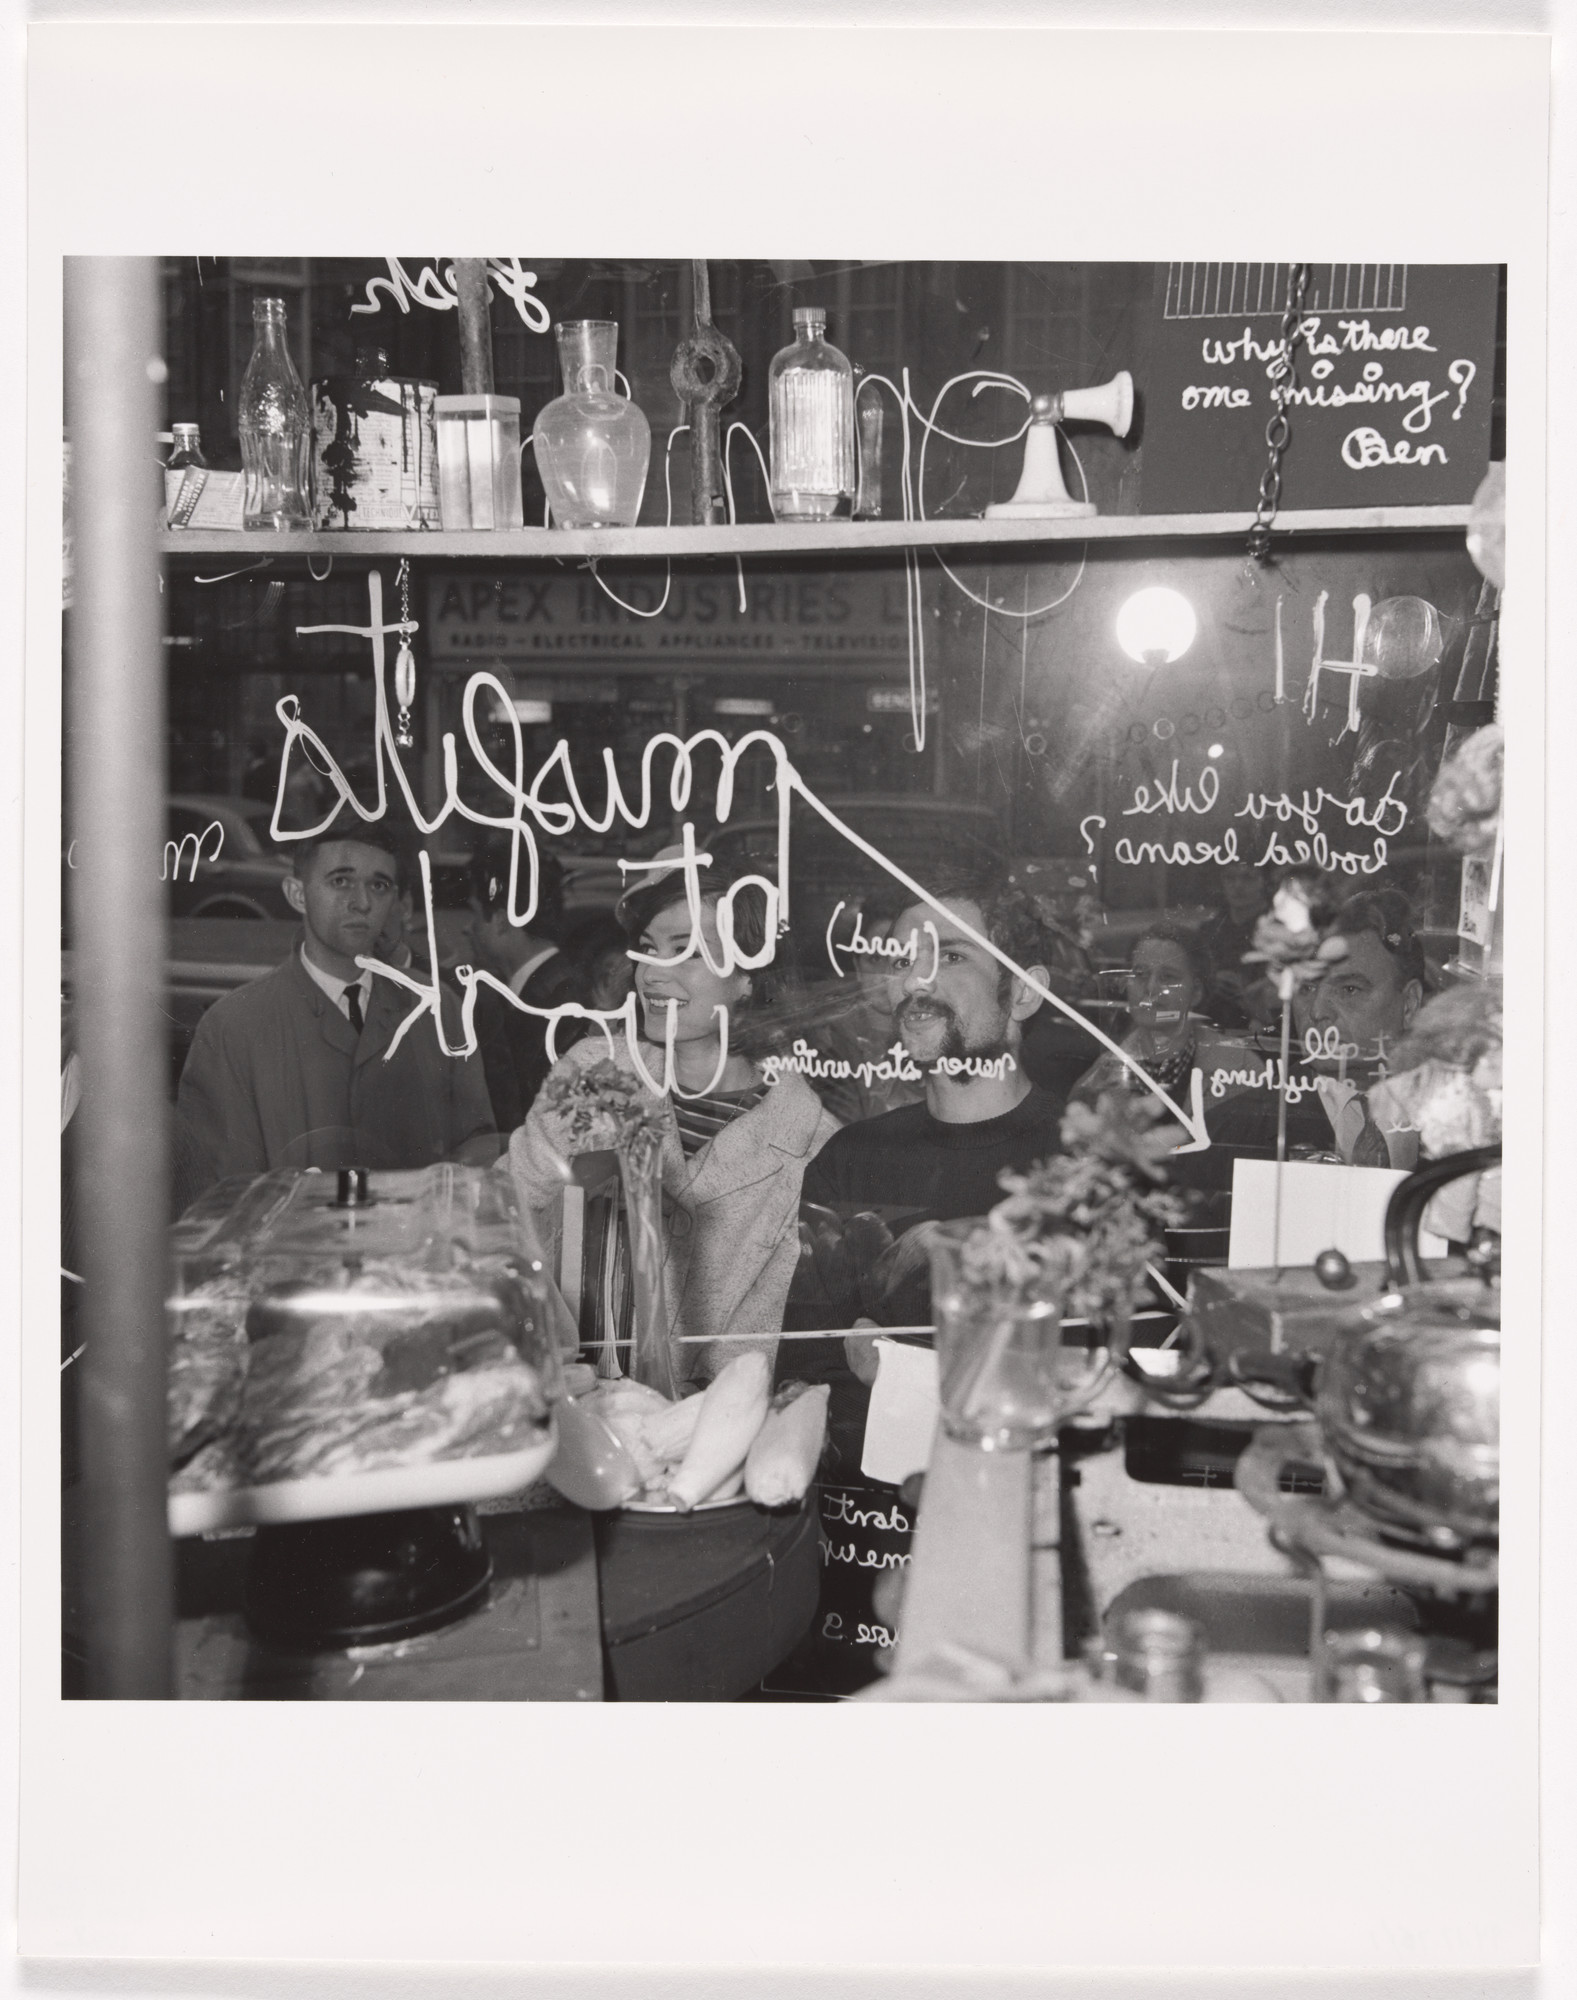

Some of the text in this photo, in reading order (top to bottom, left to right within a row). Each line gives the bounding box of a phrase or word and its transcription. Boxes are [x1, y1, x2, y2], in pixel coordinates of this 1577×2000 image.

[1203, 326, 1287, 379] why
[1338, 319, 1438, 353] there
[1182, 386, 1252, 410] one
[1342, 427, 1449, 470] Ben
[437, 580, 554, 623] APEX
[577, 579, 851, 625] INDUSTRIES
[449, 633, 508, 649] RADIO
[532, 633, 646, 650] ELECTRICAL
[658, 633, 773, 650] APPLIANCES
